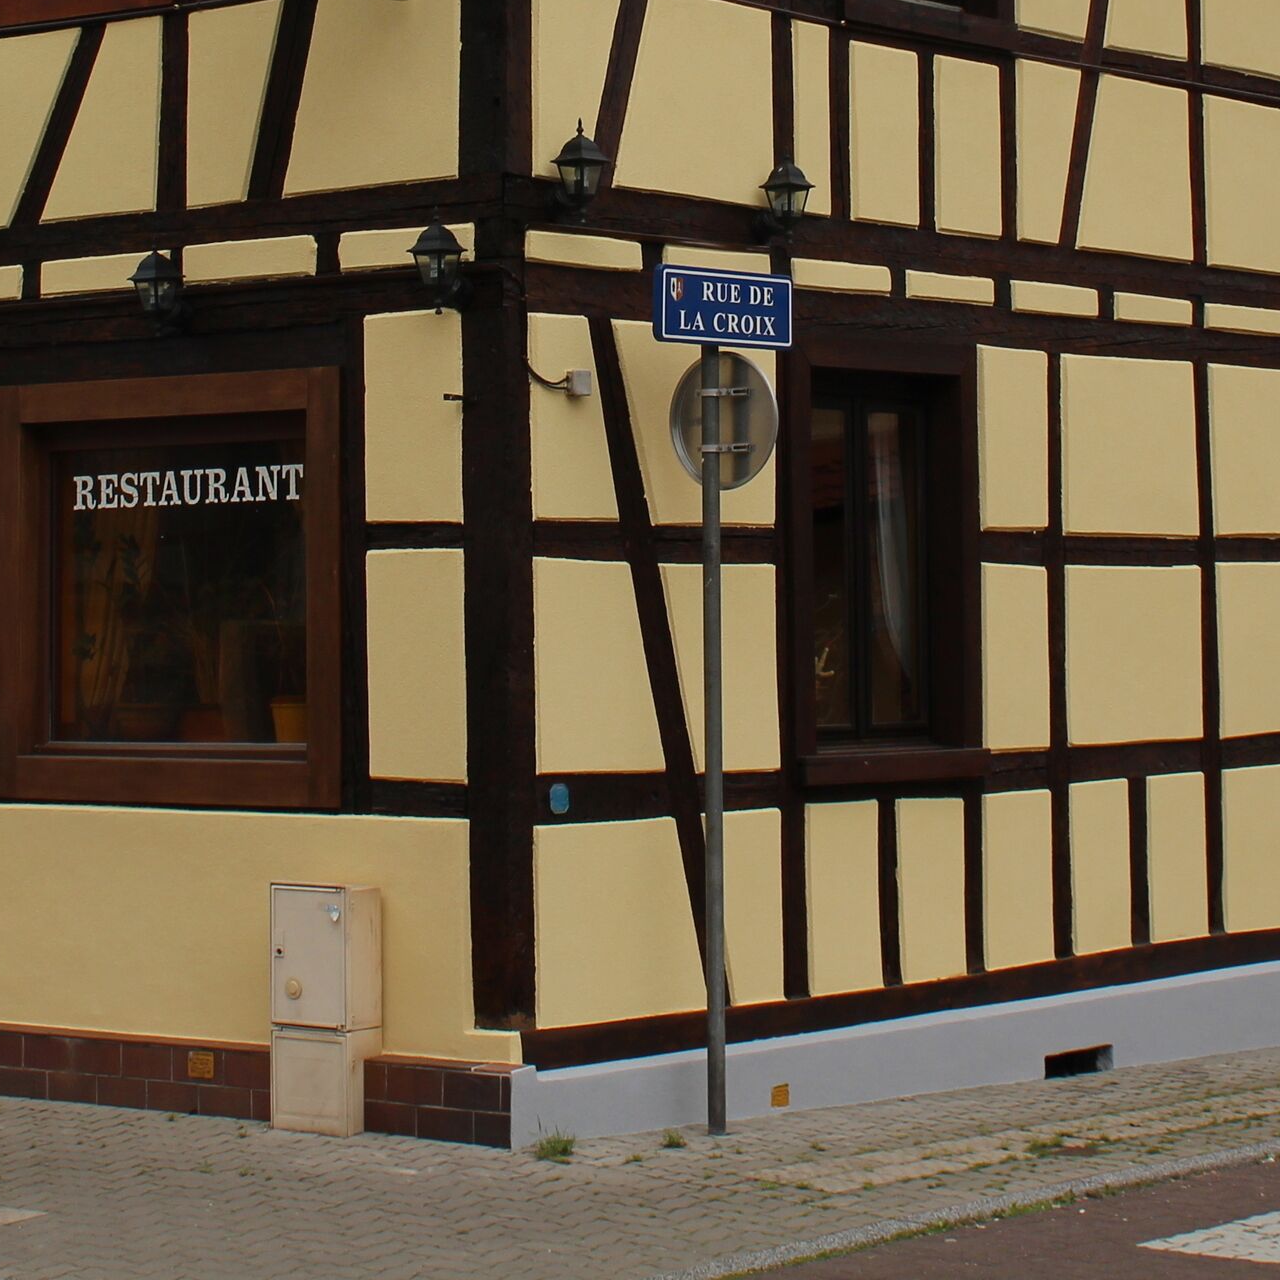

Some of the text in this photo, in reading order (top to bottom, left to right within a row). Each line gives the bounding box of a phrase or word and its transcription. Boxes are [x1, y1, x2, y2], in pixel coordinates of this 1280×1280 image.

[702, 281, 774, 306] RUE DE
[679, 310, 776, 337] LA CROIX
[73, 464, 304, 511] RESTAURANT
